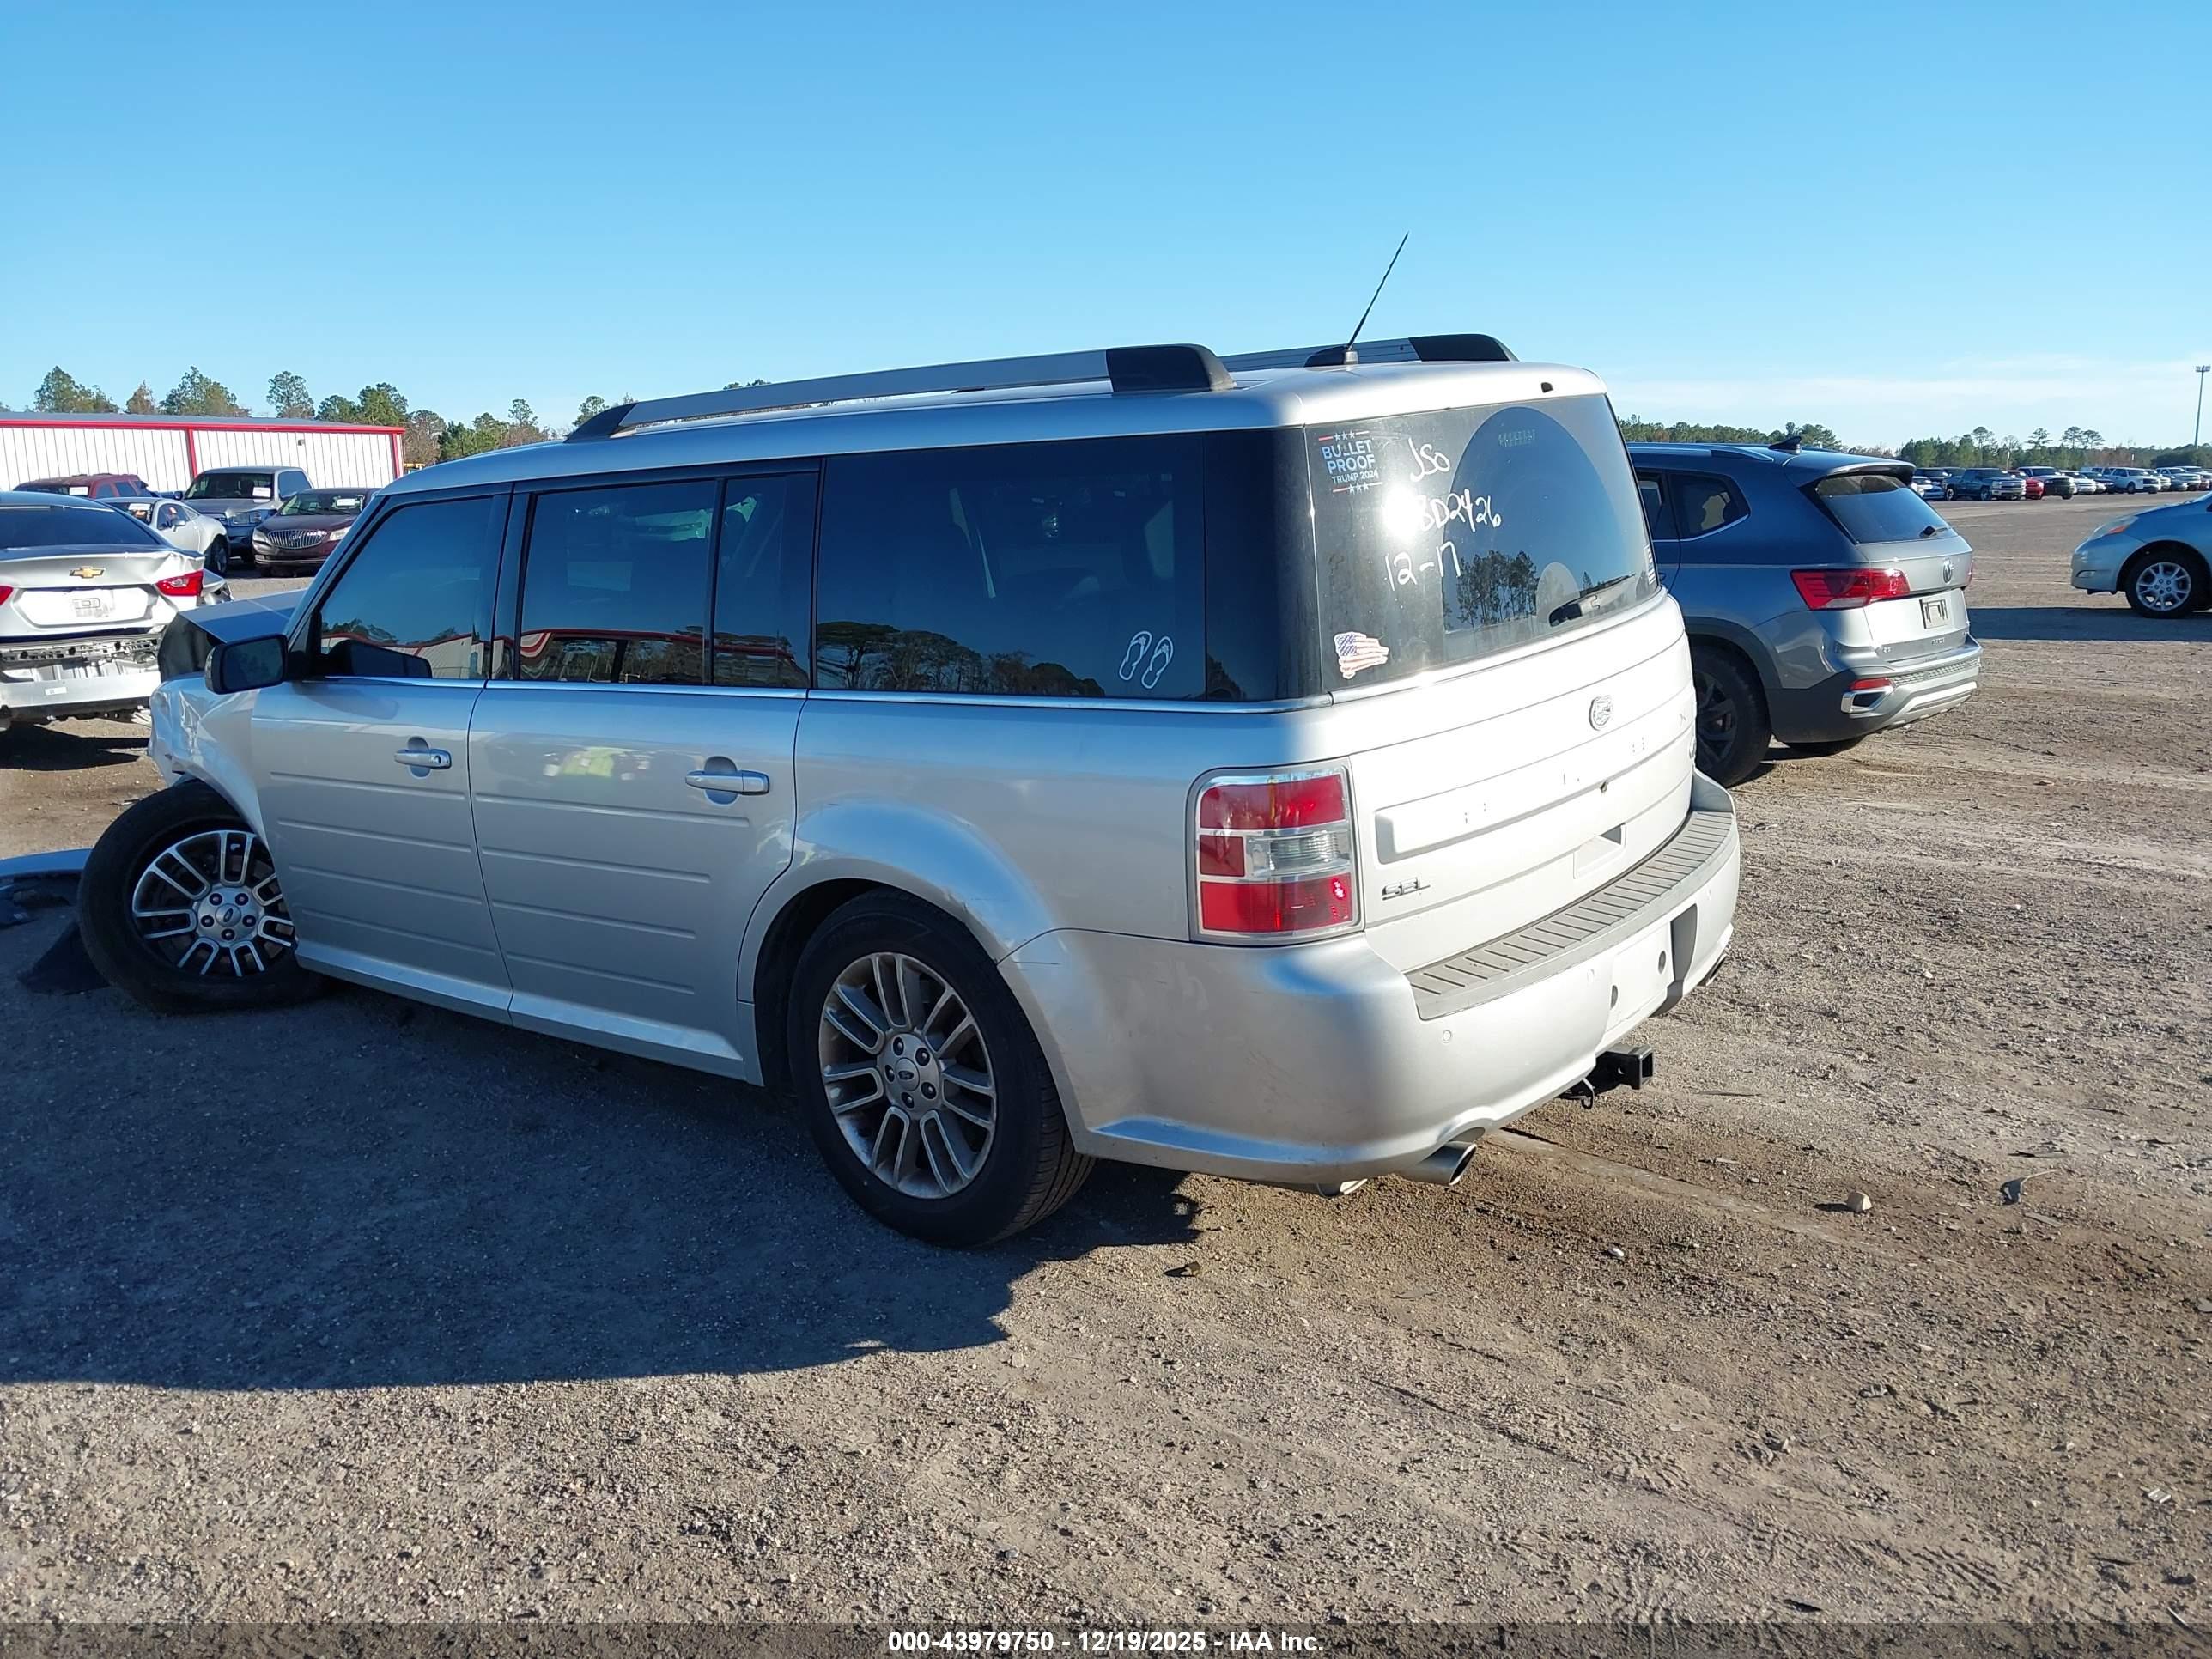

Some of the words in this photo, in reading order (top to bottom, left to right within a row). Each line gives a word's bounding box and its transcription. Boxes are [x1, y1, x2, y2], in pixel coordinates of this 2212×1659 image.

[1322, 439, 1373, 459] BULLET
[1326, 453, 1376, 475] PROOF
[1332, 472, 1358, 485] TRUMP
[1359, 469, 1380, 480] 2024
